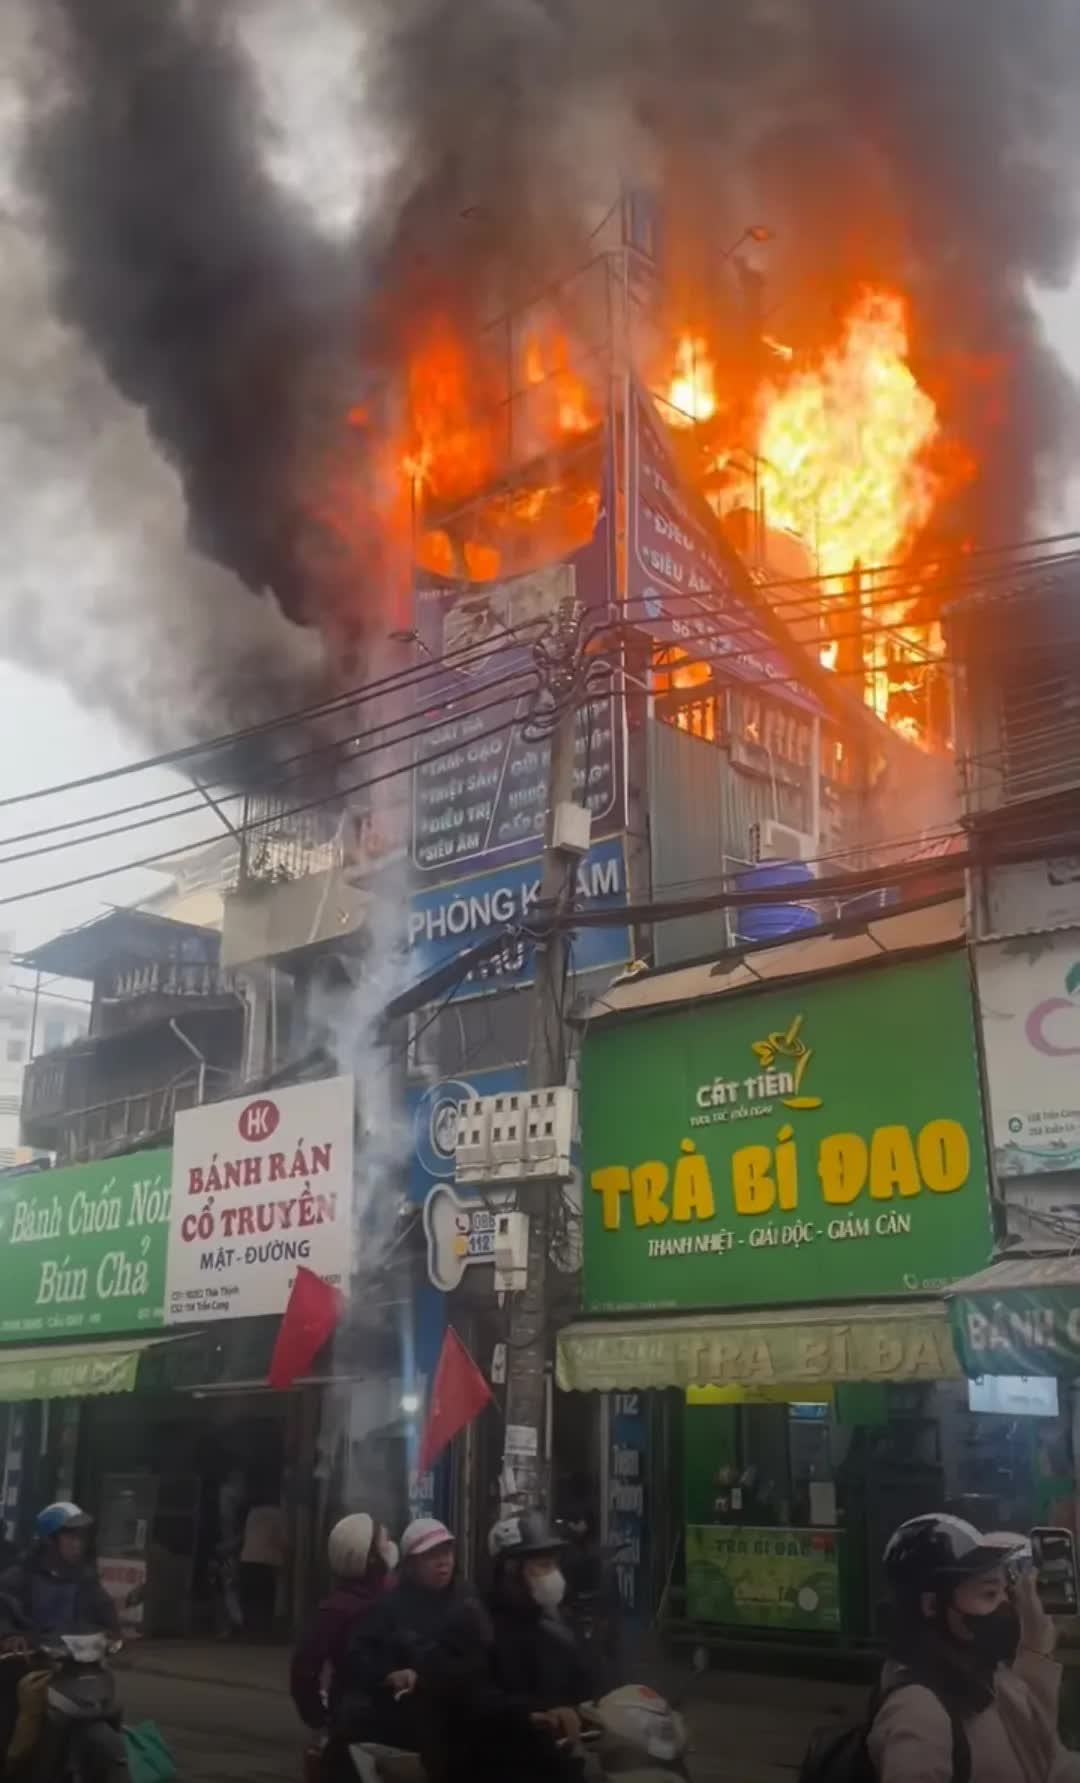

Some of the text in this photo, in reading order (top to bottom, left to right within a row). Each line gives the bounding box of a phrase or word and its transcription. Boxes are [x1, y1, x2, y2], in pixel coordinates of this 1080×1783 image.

[407, 858, 619, 945] PHÒNG KÁM
[247, 1108, 269, 1135] HK
[188, 1138, 332, 1195] BÁNH RÁN
[591, 1118, 971, 1230] TRÀ BÍ ĐAO
[10, 1175, 172, 1243] Bánh Cuốn Nón
[181, 1181, 337, 1242] CỔ TRUYỀN
[647, 1237, 692, 1257] THANH
[693, 1228, 735, 1256] NHIỆT
[750, 1220, 779, 1247] GIẢI
[781, 1218, 814, 1248] ĐỘC
[827, 1212, 870, 1240] GIẢM
[876, 1210, 912, 1235] CÂN
[36, 1237, 151, 1304] Bún Chả
[870, 1322, 945, 1375] ĐA
[967, 1300, 1057, 1351] BÁNH
